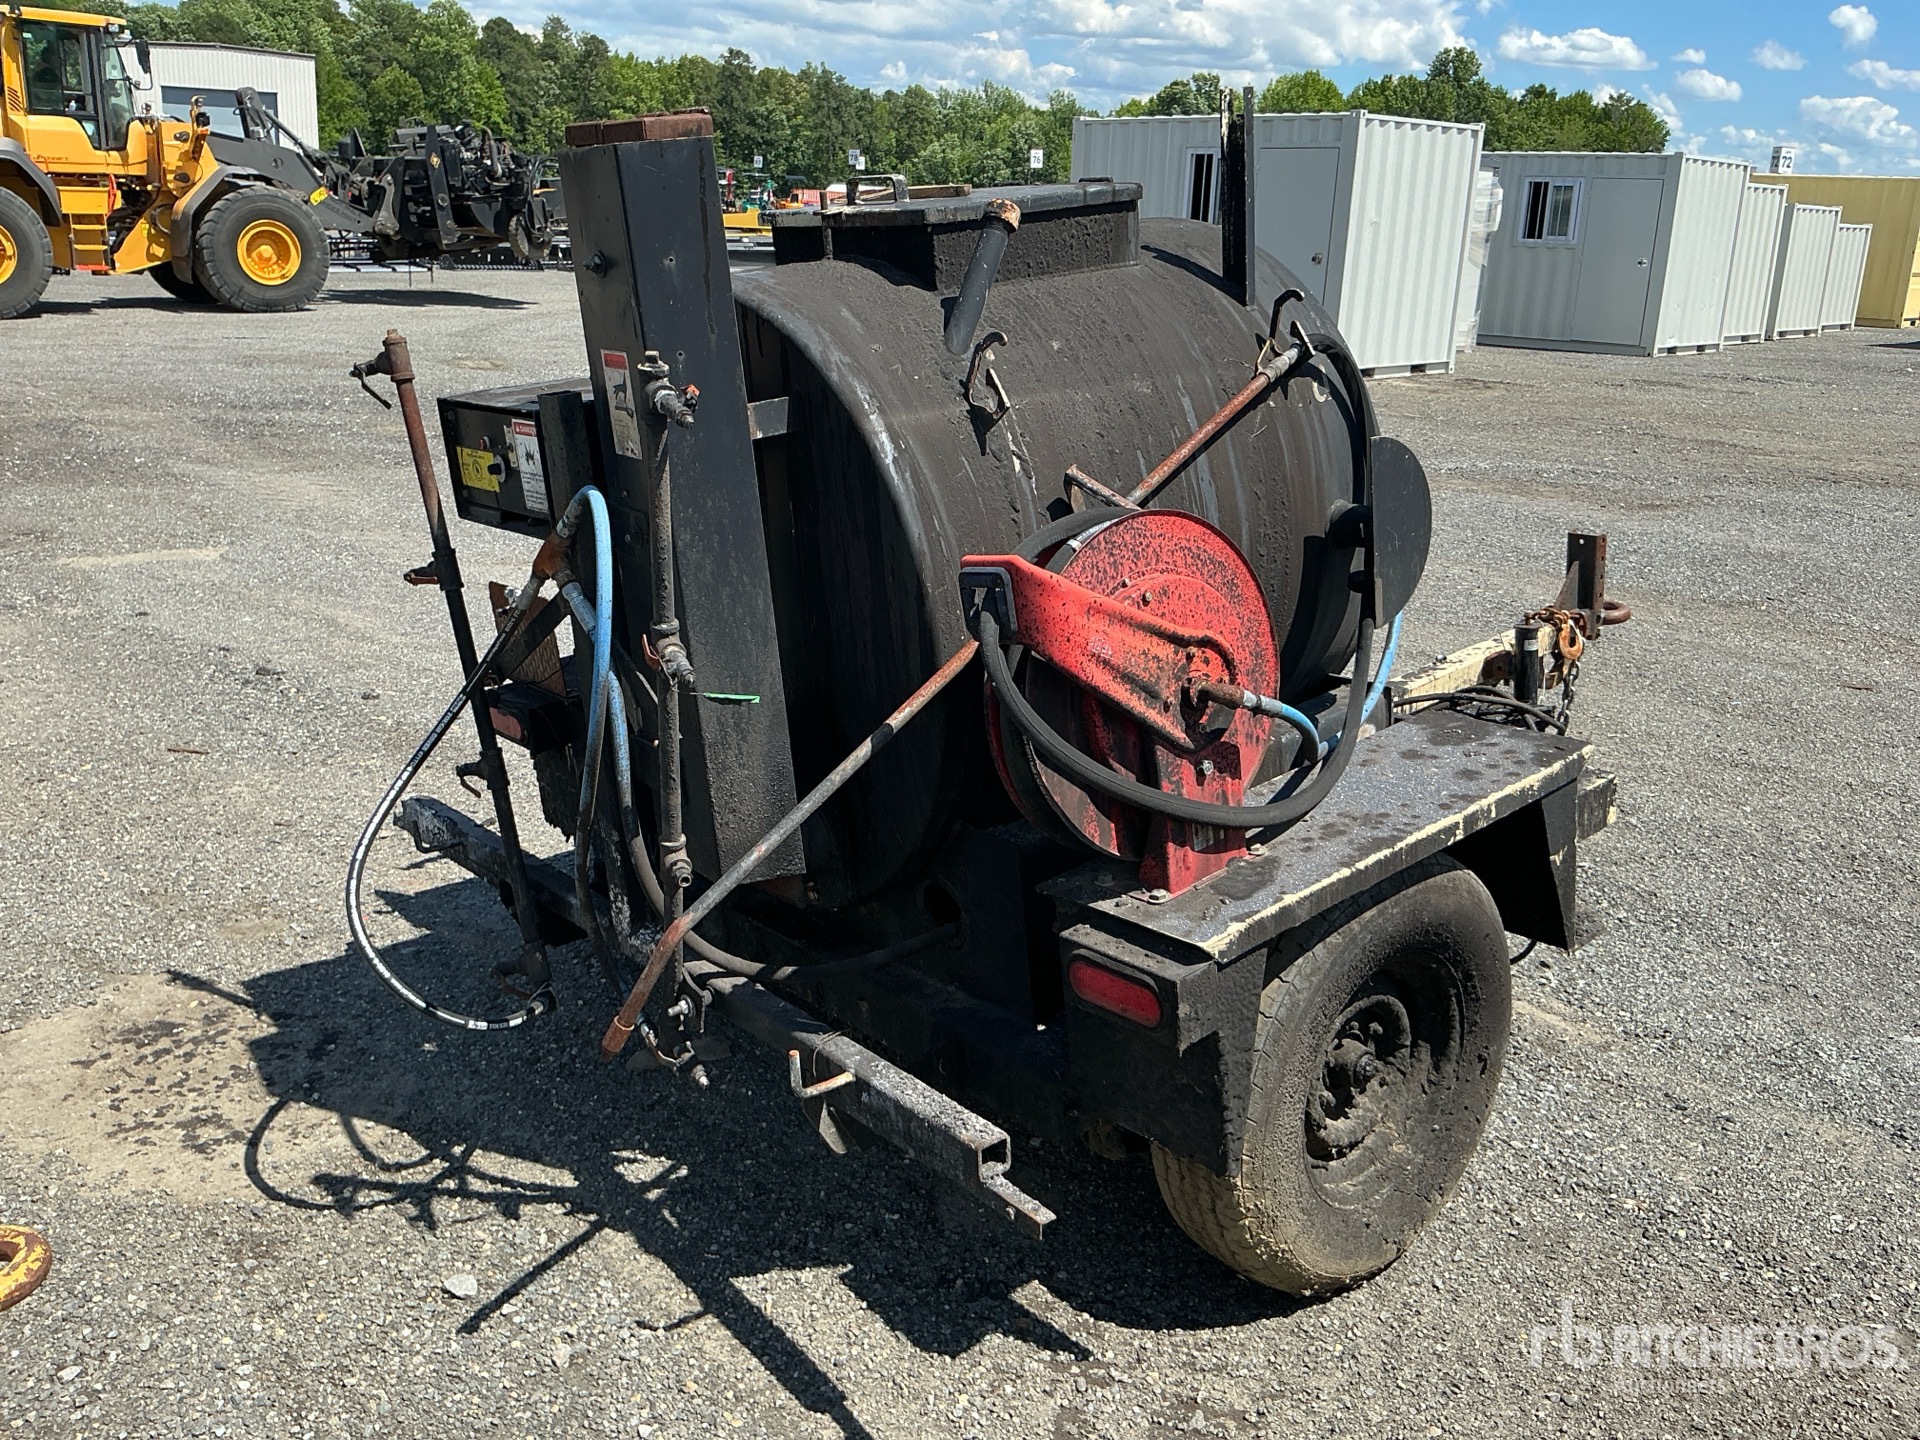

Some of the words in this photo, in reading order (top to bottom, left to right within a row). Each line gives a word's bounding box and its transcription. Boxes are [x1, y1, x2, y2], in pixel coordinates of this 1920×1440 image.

[1032, 155, 1041, 164] 76
[1771, 155, 1780, 168] 72
[1782, 155, 1792, 168] 72
[437, 712, 453, 733] TOUGH
[422, 733, 438, 751] COVER
